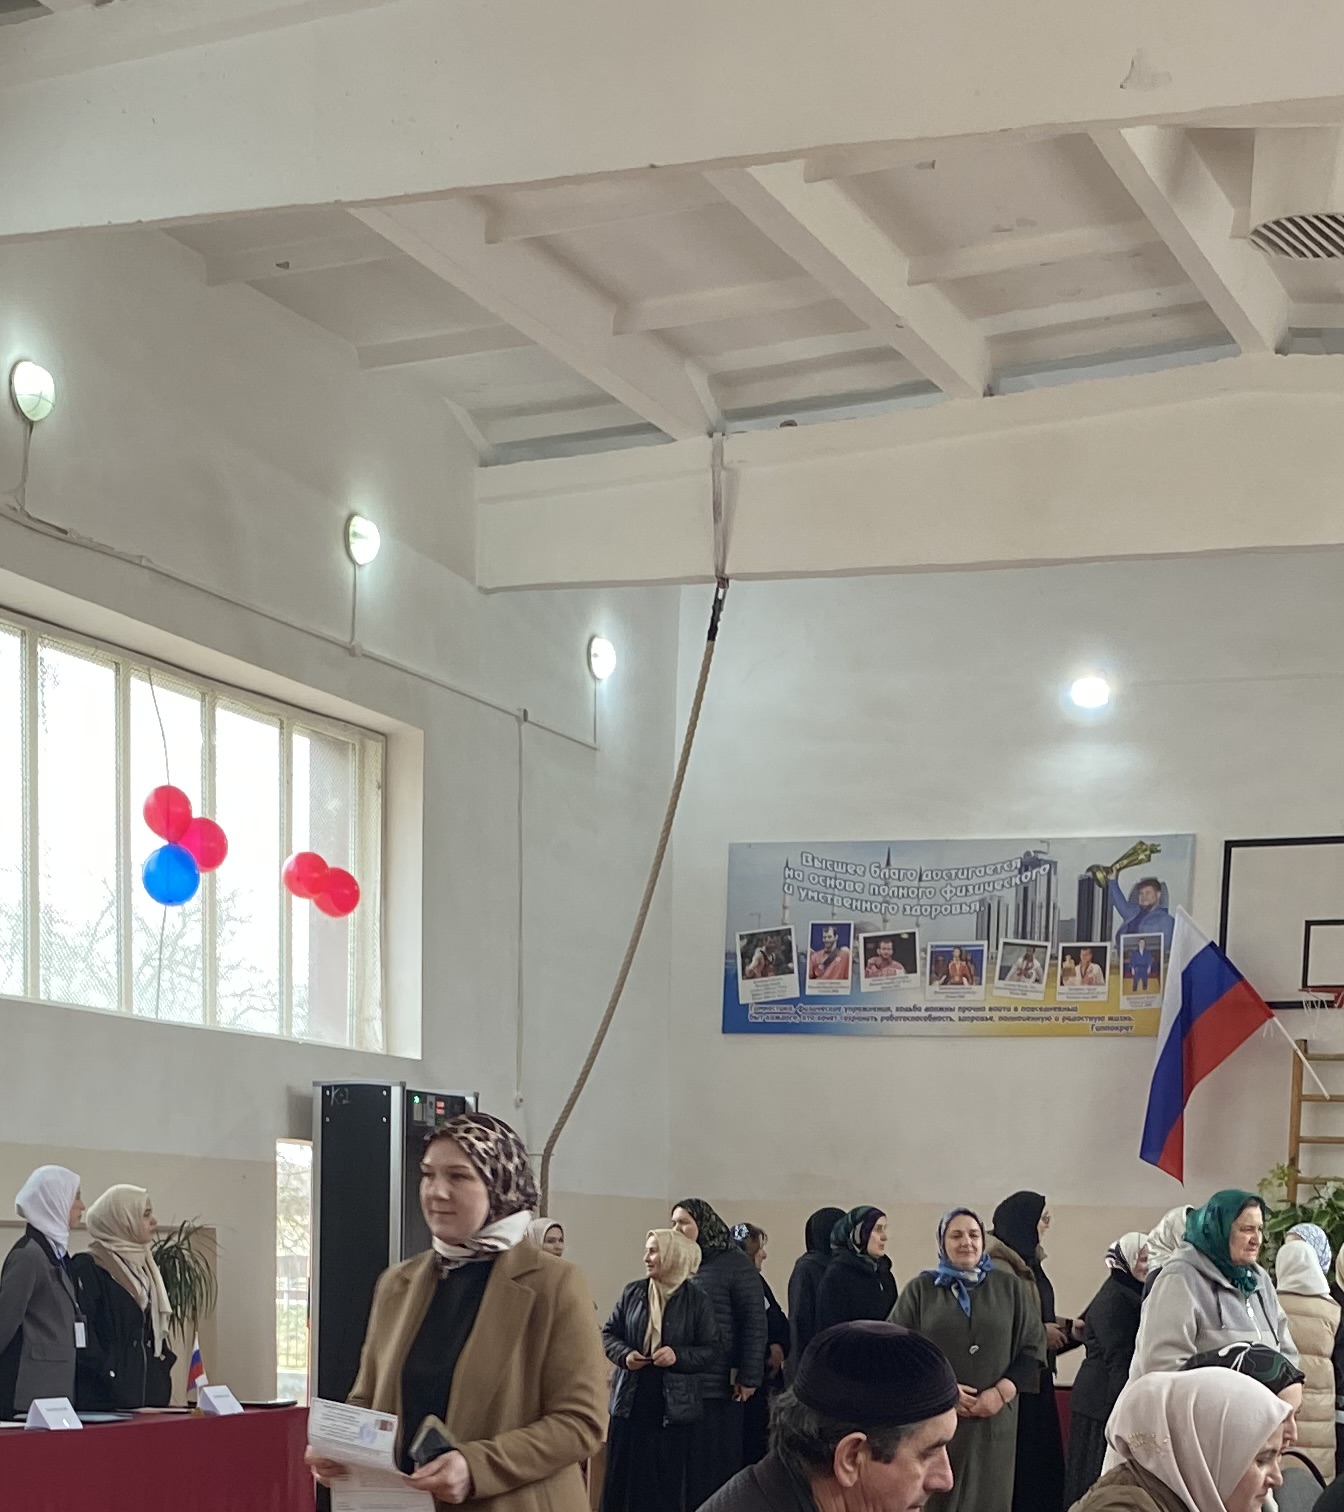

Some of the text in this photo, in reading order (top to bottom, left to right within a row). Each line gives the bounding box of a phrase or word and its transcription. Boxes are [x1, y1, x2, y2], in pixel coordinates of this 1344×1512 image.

[784, 863, 1051, 902] на основе полного физического
[801, 851, 1022, 881] Высшее благо достигается
[783, 881, 985, 920] и умственного здоровья.
